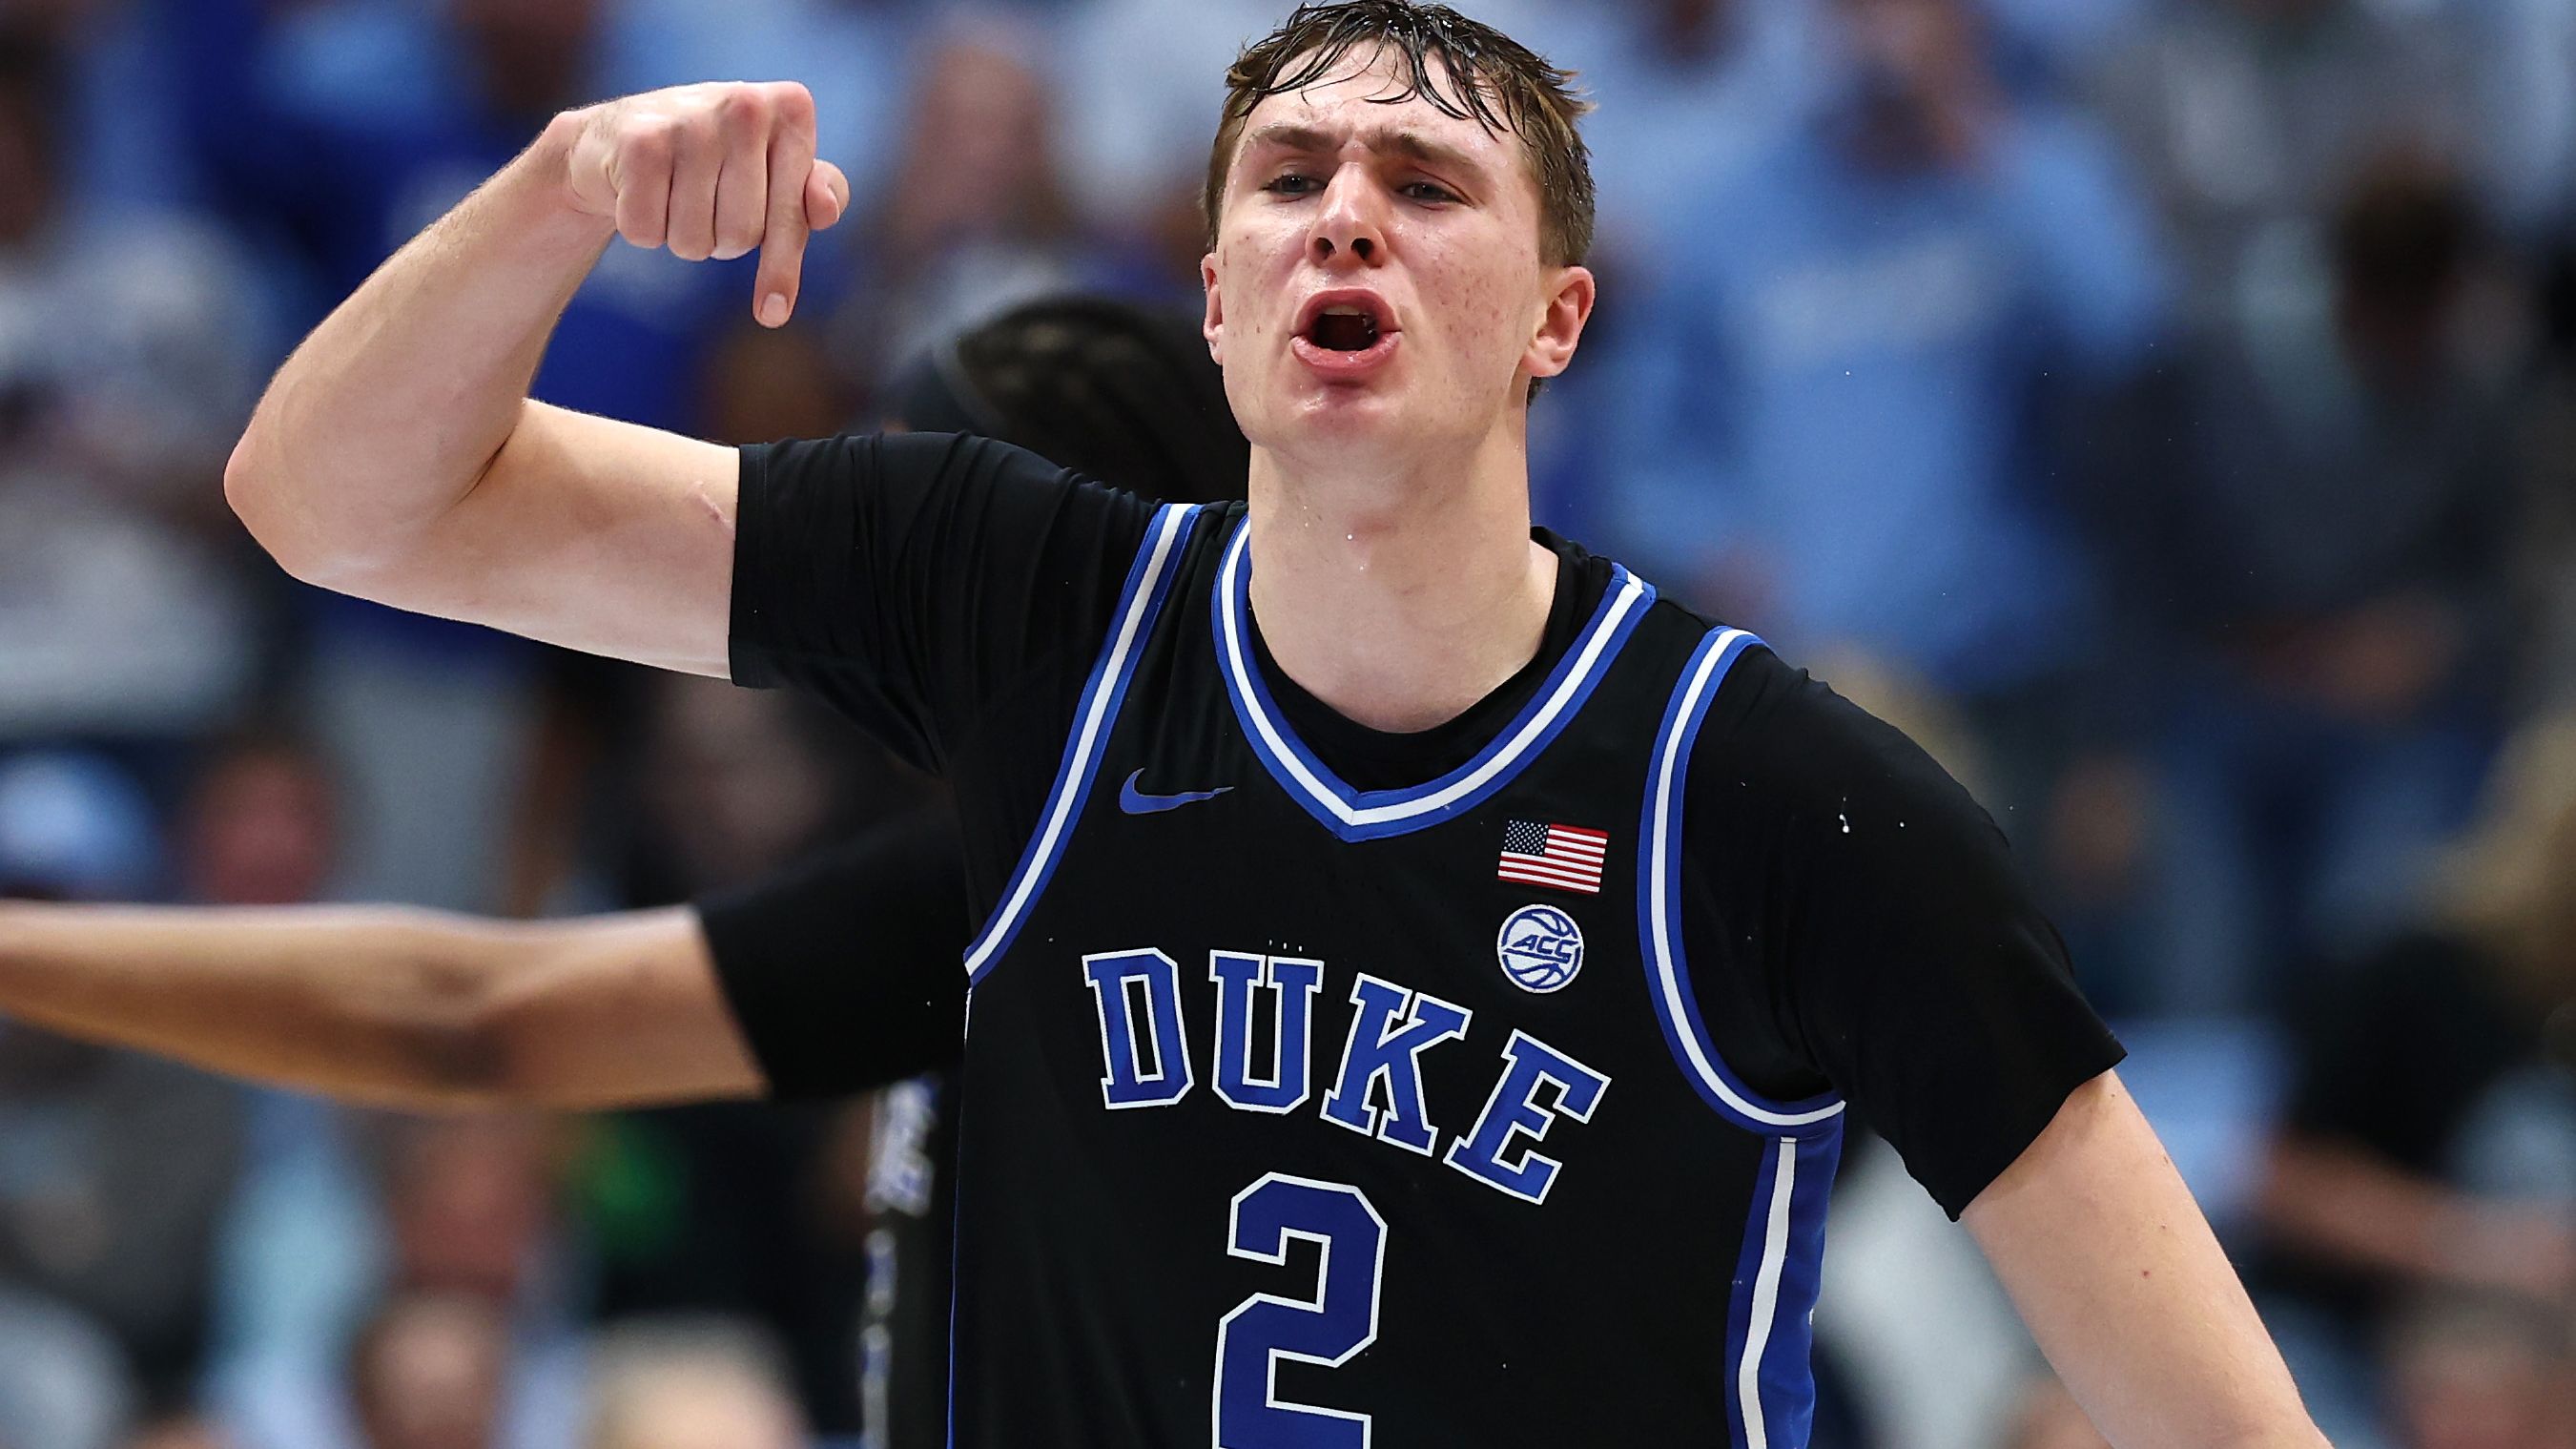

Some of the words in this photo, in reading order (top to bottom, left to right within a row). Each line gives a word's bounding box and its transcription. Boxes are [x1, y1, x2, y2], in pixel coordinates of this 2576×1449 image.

[1082, 947, 1612, 1205] DUKE
[1511, 934, 1578, 963] ACC
[1212, 1171, 1388, 1449] 2
